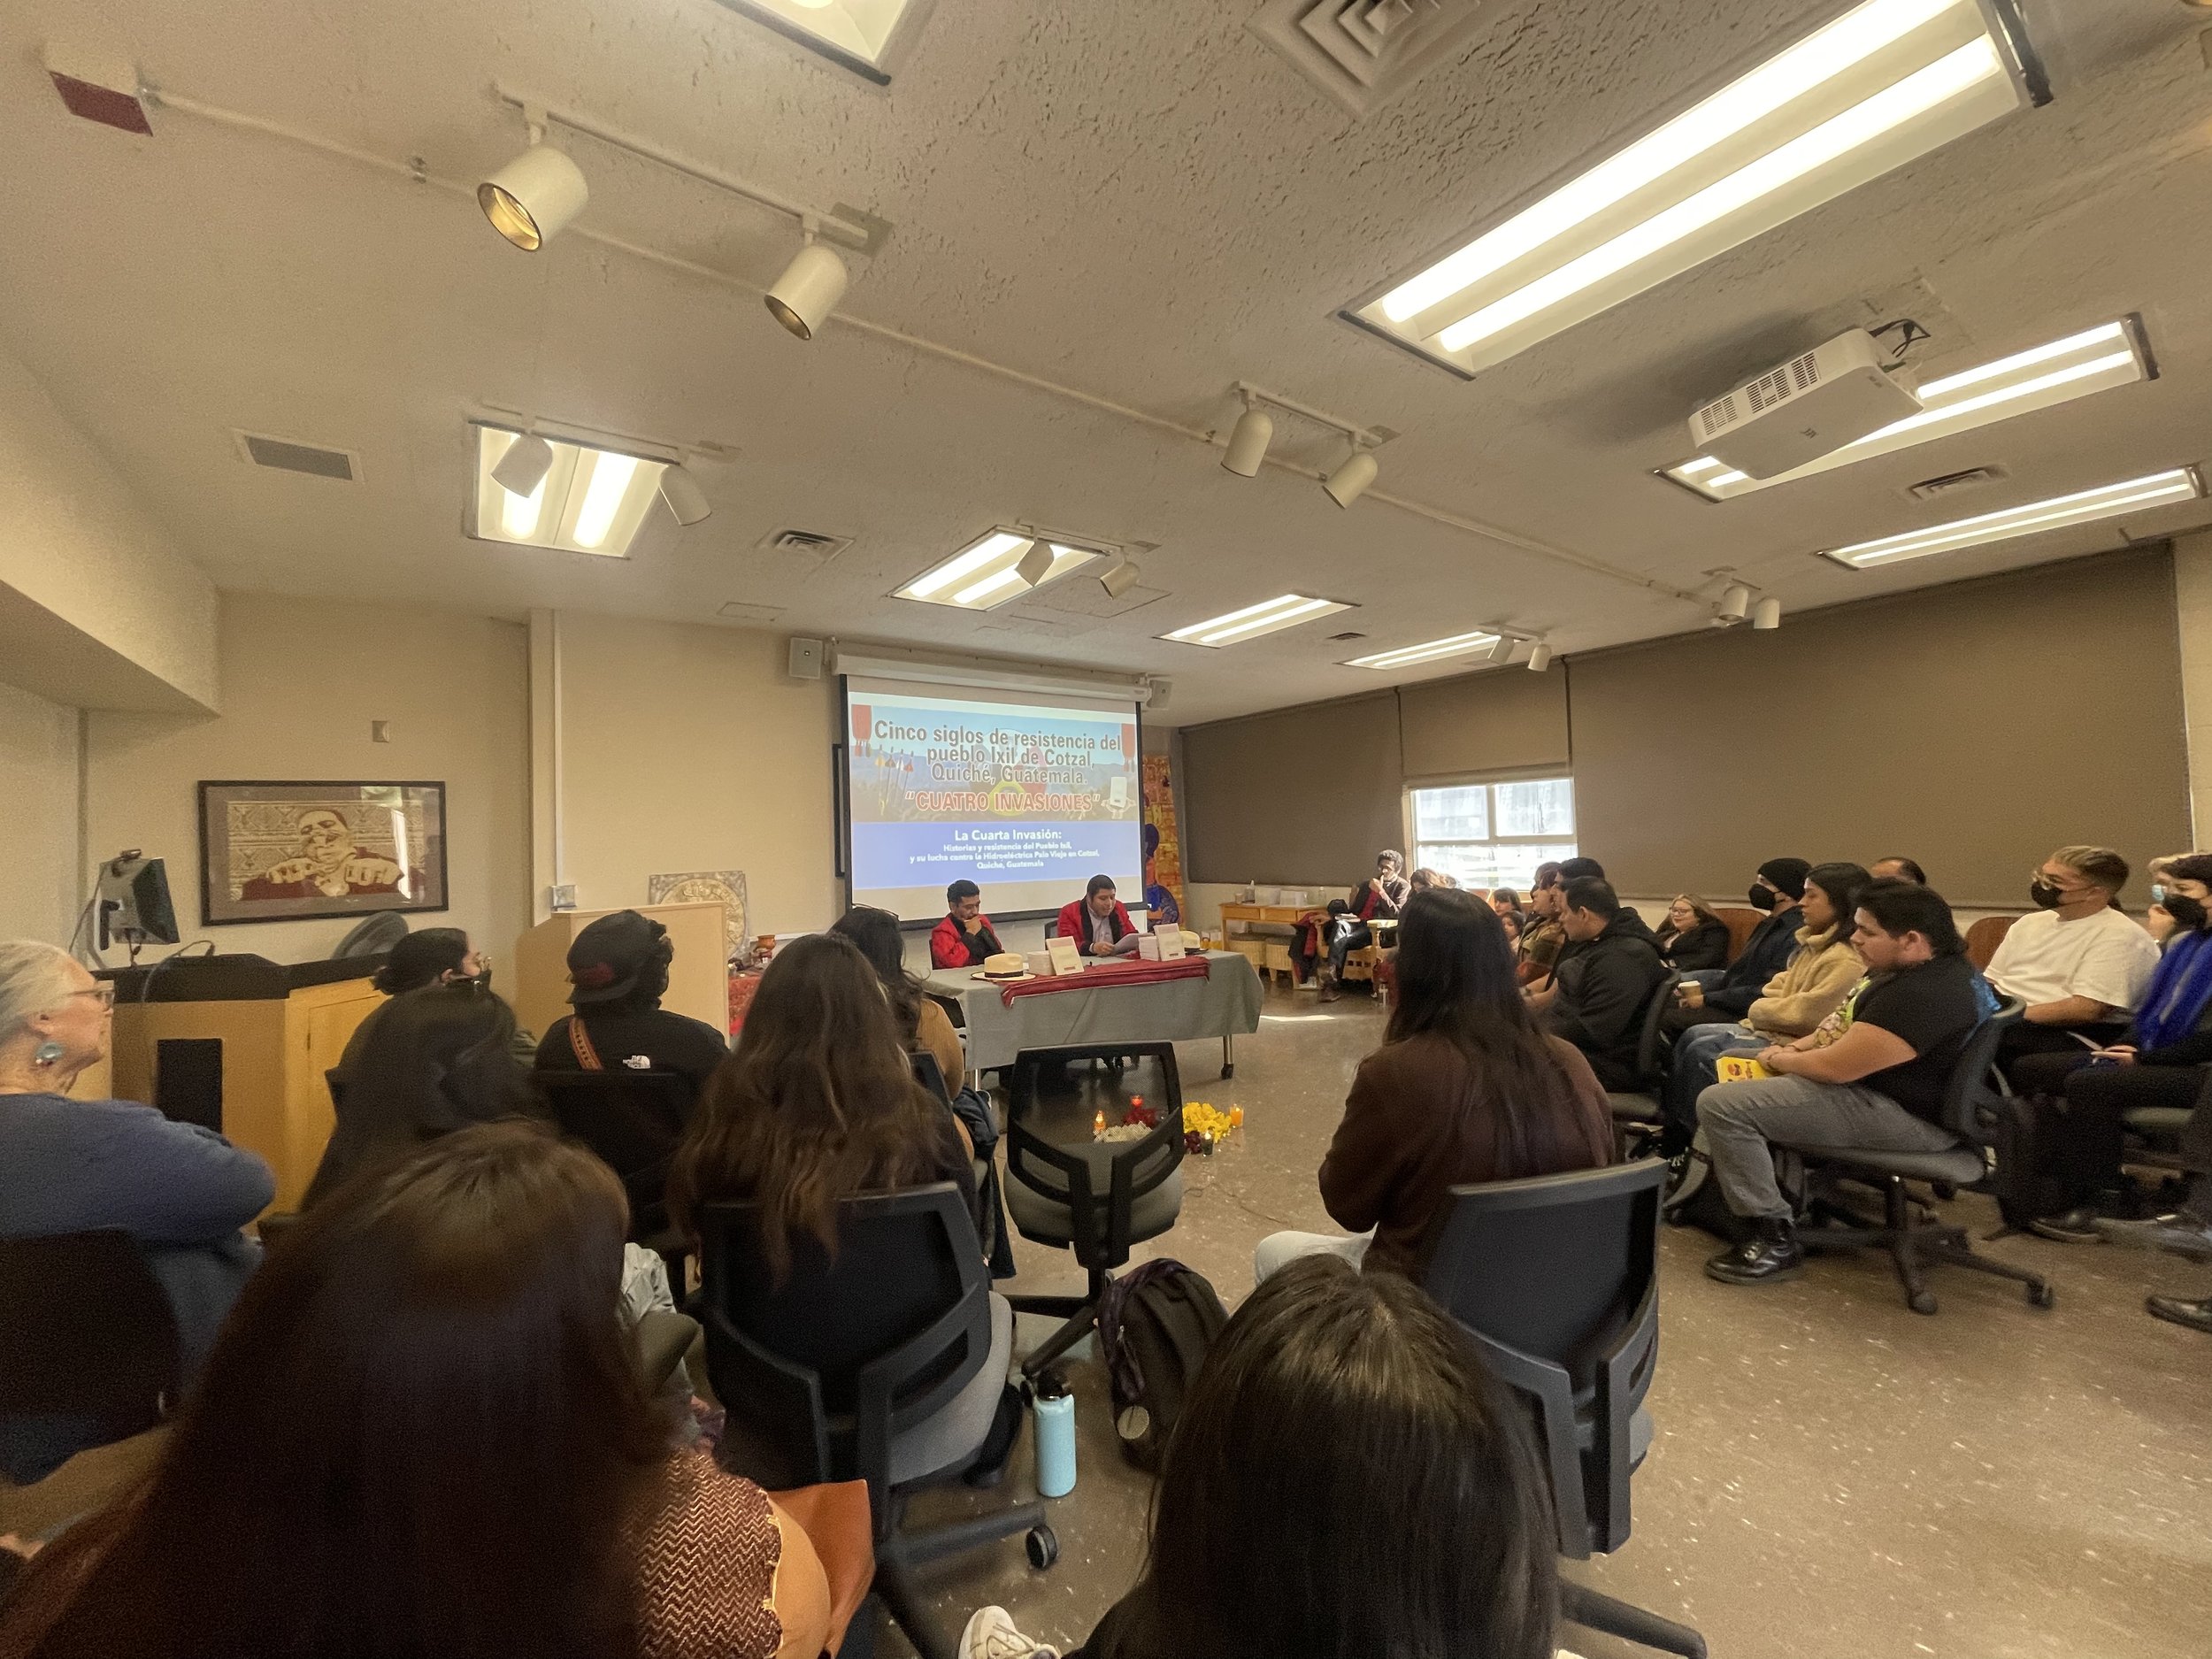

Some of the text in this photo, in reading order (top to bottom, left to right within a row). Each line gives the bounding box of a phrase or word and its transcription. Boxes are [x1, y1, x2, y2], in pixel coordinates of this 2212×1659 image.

[874, 720, 1121, 750] Cinco siglos de resistencia del
[927, 745, 1095, 770] pueblo Ixil de Cotzal,
[932, 763, 1088, 785] Quiché, Guatemala.
[955, 828, 1062, 841] La Cuarta Invasión:
[984, 842, 1022, 851] resistencia
[1049, 850, 1067, 859] Viejo
